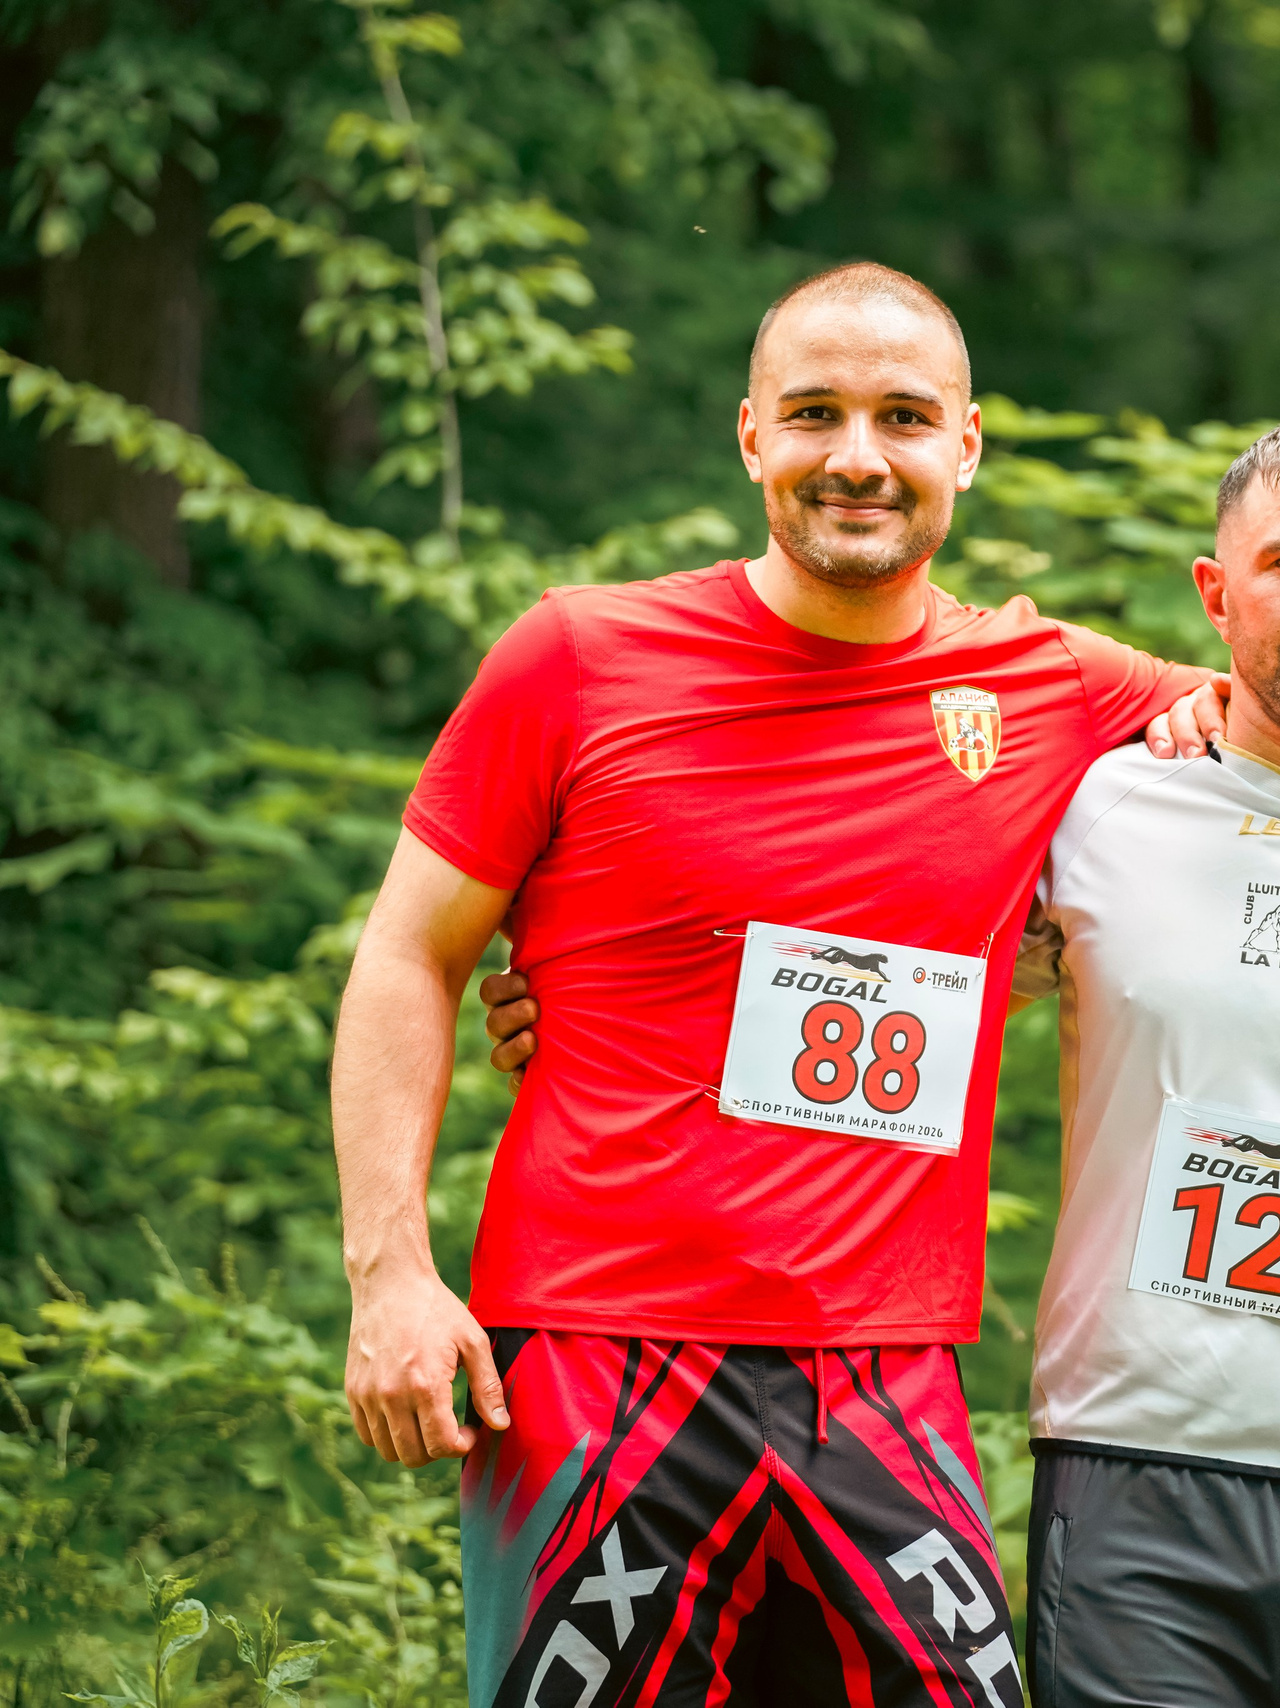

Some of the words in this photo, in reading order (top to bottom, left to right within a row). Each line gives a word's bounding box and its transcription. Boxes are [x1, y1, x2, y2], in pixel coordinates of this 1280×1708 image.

[940, 692, 989, 702] АЛАНИЯ
[1244, 895, 1255, 924] CLUB
[1240, 951, 1270, 967] LA
[771, 967, 887, 1003] BOGAL
[792, 1000, 927, 1114] 88
[742, 1099, 845, 1124] СПОРТИВНЫЙ
[849, 1114, 915, 1134] МАРАФОН
[918, 1125, 943, 1138] 2026
[1150, 1280, 1256, 1310] СПОРТИВНЫЙ
